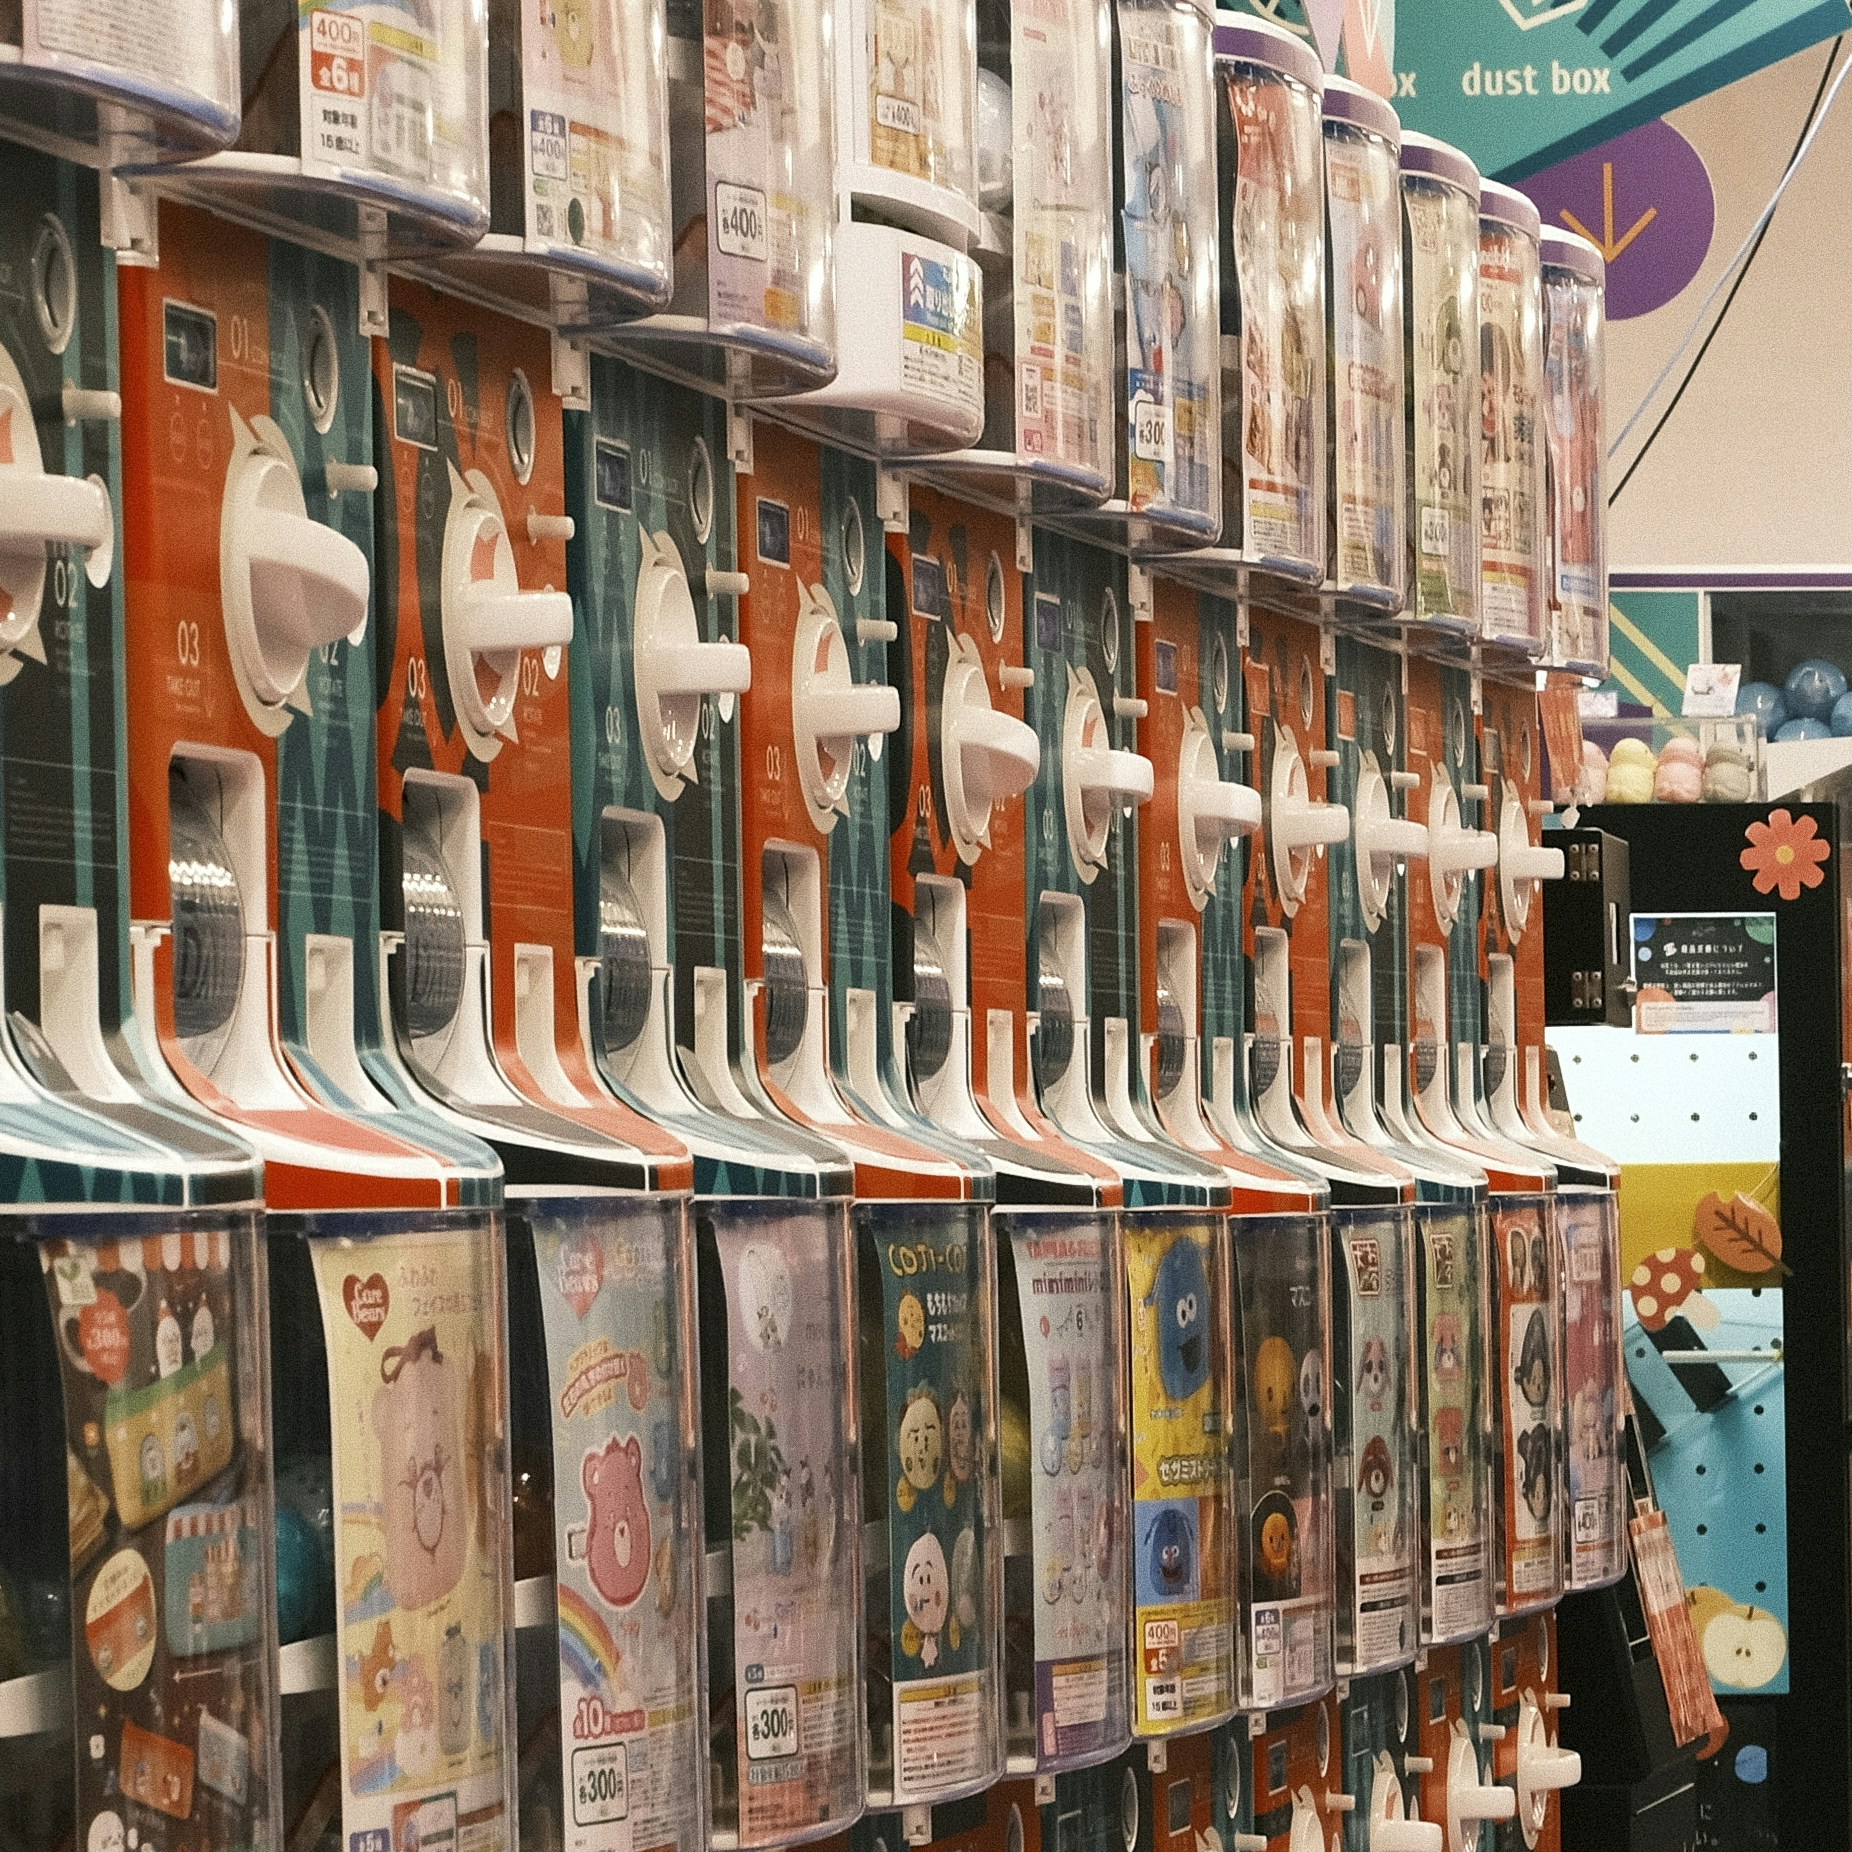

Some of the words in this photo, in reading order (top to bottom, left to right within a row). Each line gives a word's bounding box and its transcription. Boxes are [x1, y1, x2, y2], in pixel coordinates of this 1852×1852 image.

[1390, 68, 1418, 98] ox
[1462, 62, 1541, 98] dust
[1551, 64, 1611, 98] box
[56, 561, 79, 608] 02
[178, 620, 200, 666] 03
[408, 656, 427, 699] 03
[523, 656, 540, 697] 02
